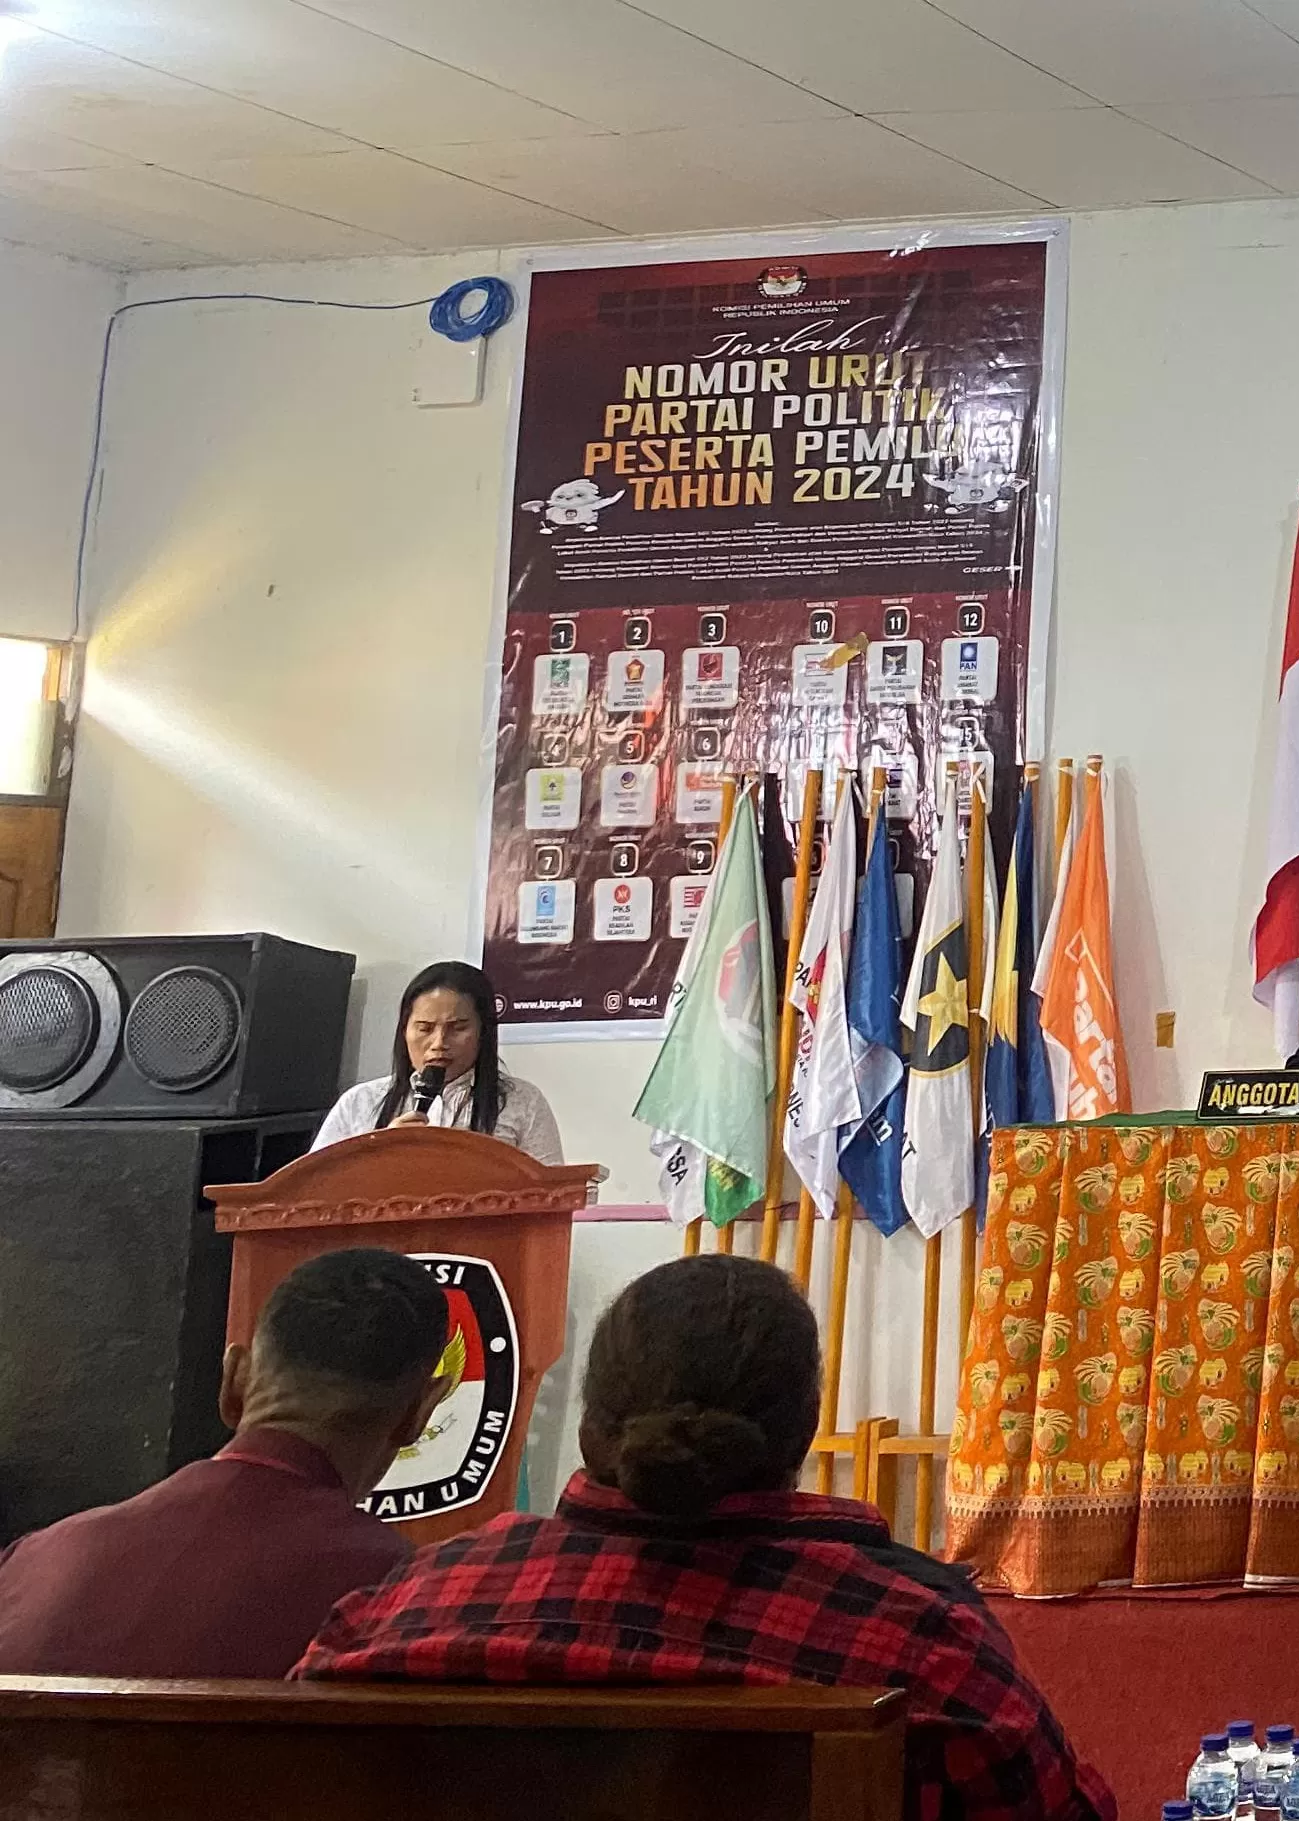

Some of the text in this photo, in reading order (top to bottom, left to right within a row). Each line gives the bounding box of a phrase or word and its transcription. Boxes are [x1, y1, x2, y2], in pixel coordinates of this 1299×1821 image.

[753, 300, 813, 311] PEMILIHAN
[815, 298, 850, 307] UMUM
[723, 306, 839, 319] REPUBLIK INDONESIA
[692, 314, 890, 359] Inilah
[624, 351, 930, 400] NOMOR URUT
[604, 387, 950, 438] PARTAI POLITIK
[584, 433, 774, 476] PESERTA
[628, 463, 915, 511] TAHUN 2024
[814, 619, 828, 633] 10
[888, 616, 902, 630] 11
[963, 612, 979, 627] 12
[558, 630, 566, 644] 1
[632, 626, 642, 641] 2
[707, 623, 717, 638] 3
[626, 740, 635, 754] 5
[702, 736, 711, 751] 6
[544, 856, 553, 870] 7
[619, 853, 628, 868] 8
[695, 850, 705, 865] 9
[612, 905, 631, 914] PKS
[514, 998, 583, 1011] www.kpu.go.id
[1208, 1081, 1299, 1107] ANGGOTA
[440, 1410, 505, 1502] UMUM
